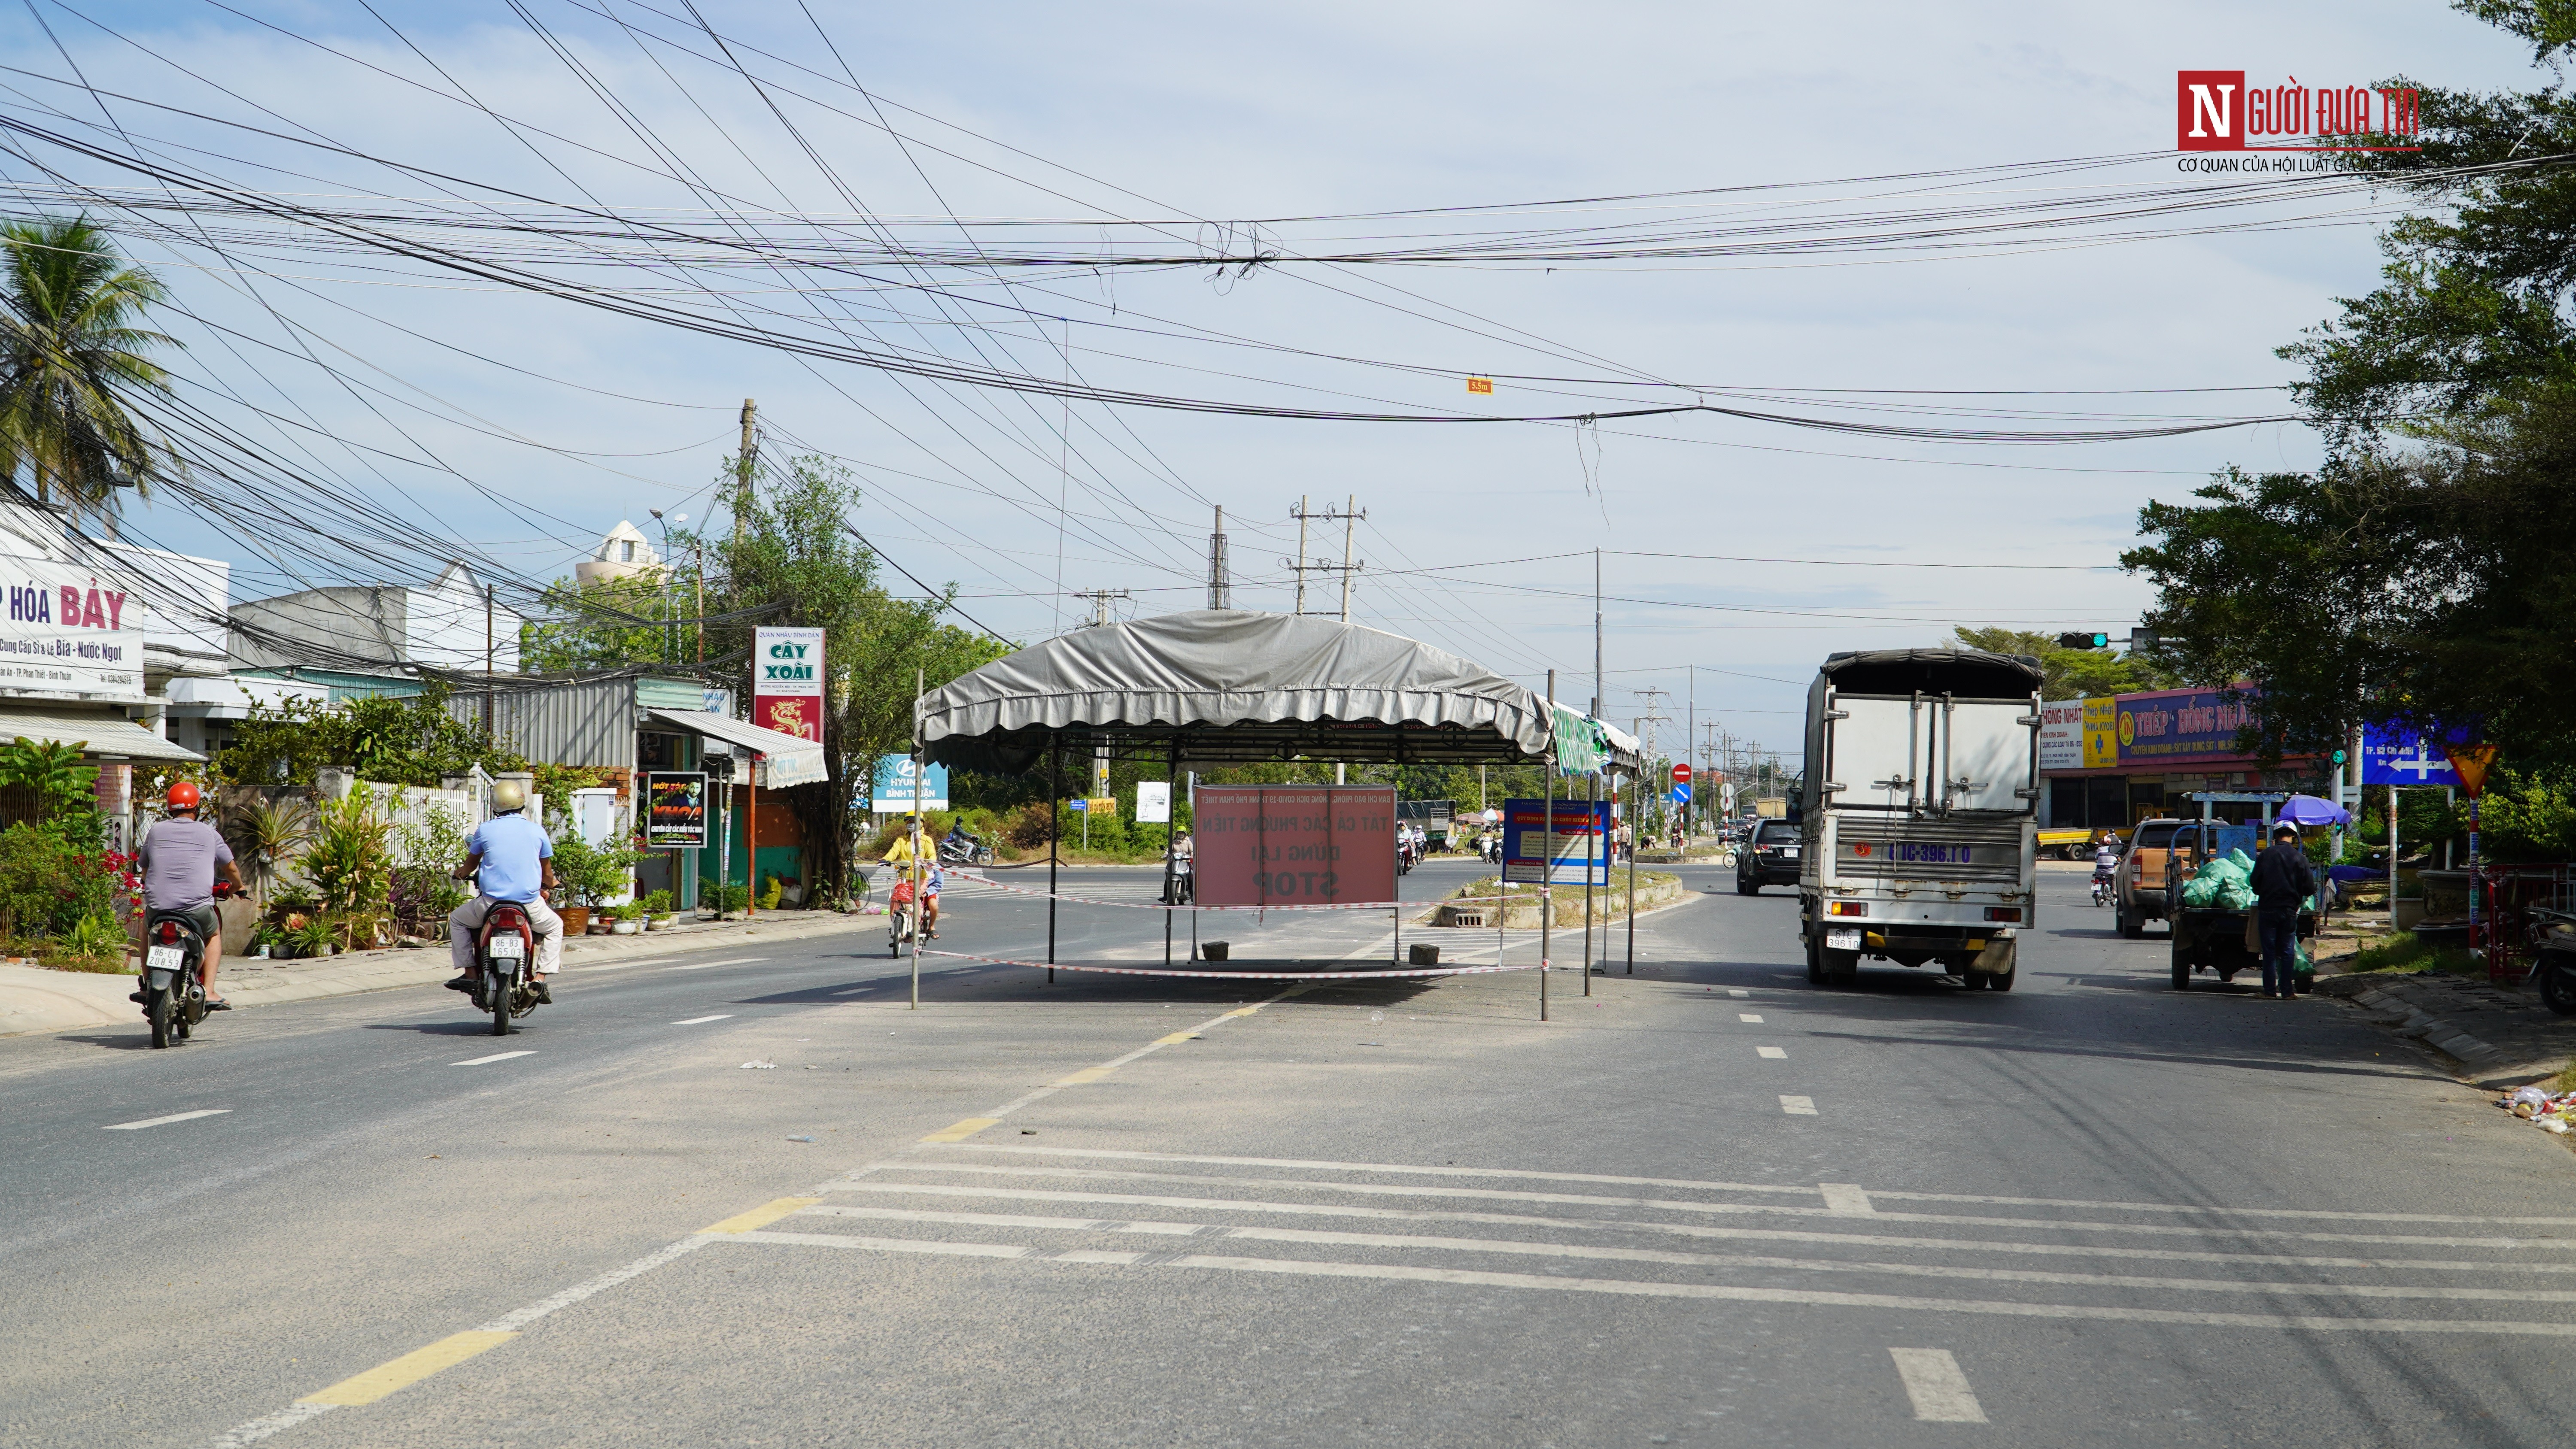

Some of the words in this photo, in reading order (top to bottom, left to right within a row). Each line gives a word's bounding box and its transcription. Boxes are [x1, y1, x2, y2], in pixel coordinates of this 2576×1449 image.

[1472, 382, 1488, 390] 5.5m
[10, 580, 50, 624] HÓA
[61, 577, 127, 630] BẢY
[0, 639, 16, 653] Cung
[19, 639, 31, 655] Cấp
[56, 639, 70, 656] Bia
[78, 641, 100, 659] Nước
[103, 643, 122, 664] Ngọt
[769, 640, 810, 659] CÂY
[7, 667, 12, 676] An
[23, 669, 33, 678] Phan
[35, 668, 45, 679] Thiết
[60, 671, 72, 682] Thuận
[763, 661, 814, 680] XOÀI
[2064, 702, 2082, 724] NHẤT
[2135, 704, 2168, 737] THÉP
[2170, 696, 2214, 734] HỐNG
[2100, 721, 2114, 731] KYOEI
[2366, 746, 2375, 755] TP.
[886, 788, 906, 797] BÌNH
[652, 806, 702, 820] KHOA
[1835, 930, 1853, 939] 61C
[496, 939, 518, 947] 86-B3
[1829, 939, 1859, 949] 396.10
[155, 948, 177, 958] 86-C1
[493, 948, 521, 957] 165.03
[149, 956, 179, 968] 208.53
